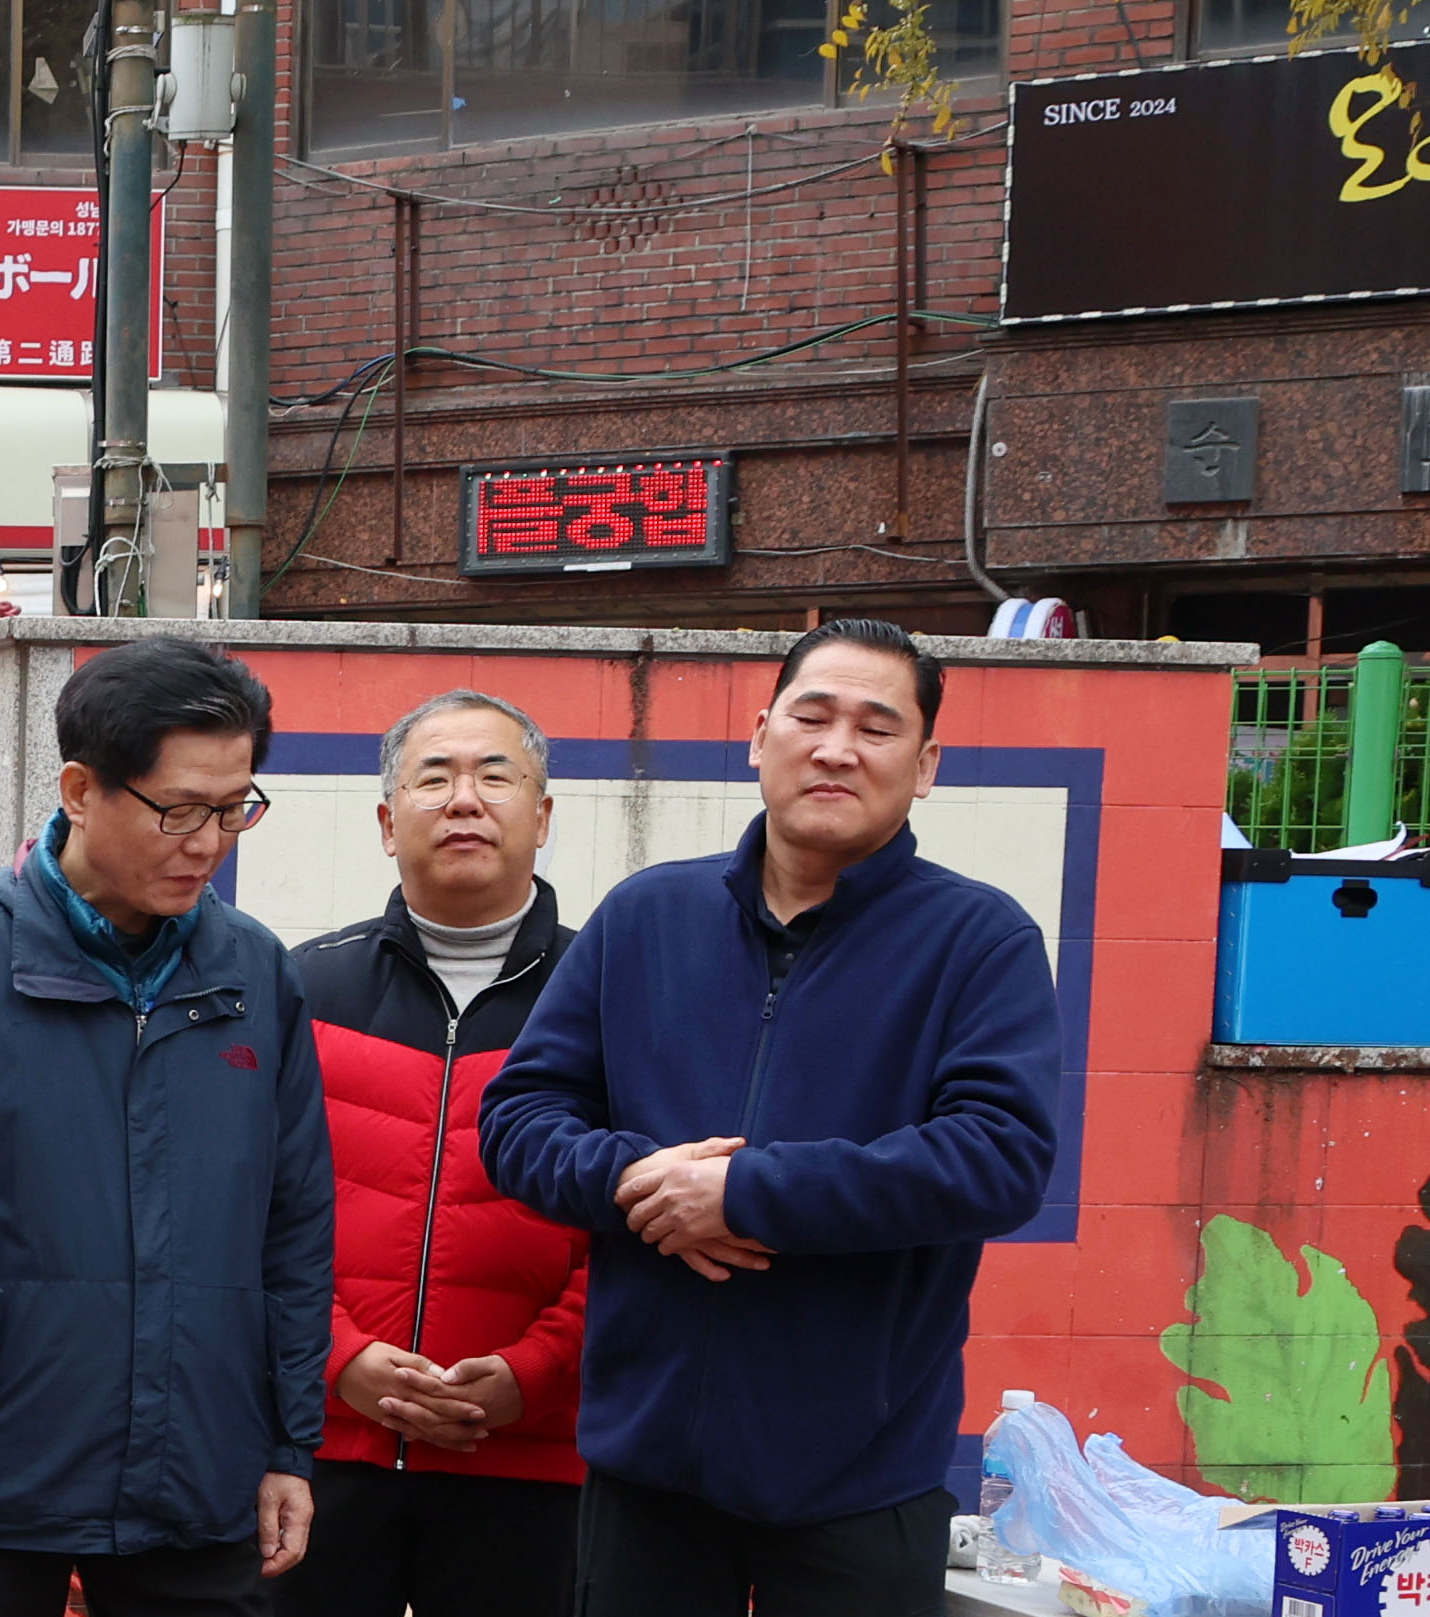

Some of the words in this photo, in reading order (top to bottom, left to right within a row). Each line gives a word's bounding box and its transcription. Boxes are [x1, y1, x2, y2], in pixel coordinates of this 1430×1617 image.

[1043, 98, 1121, 126] SINCE
[1129, 98, 1176, 118] 2024
[7, 220, 63, 237] 가맹문의
[1294, 1538, 1325, 1557] 박카스
[1350, 1538, 1394, 1571] Drive
[1395, 1526, 1430, 1549] Your
[1305, 1557, 1313, 1568] F
